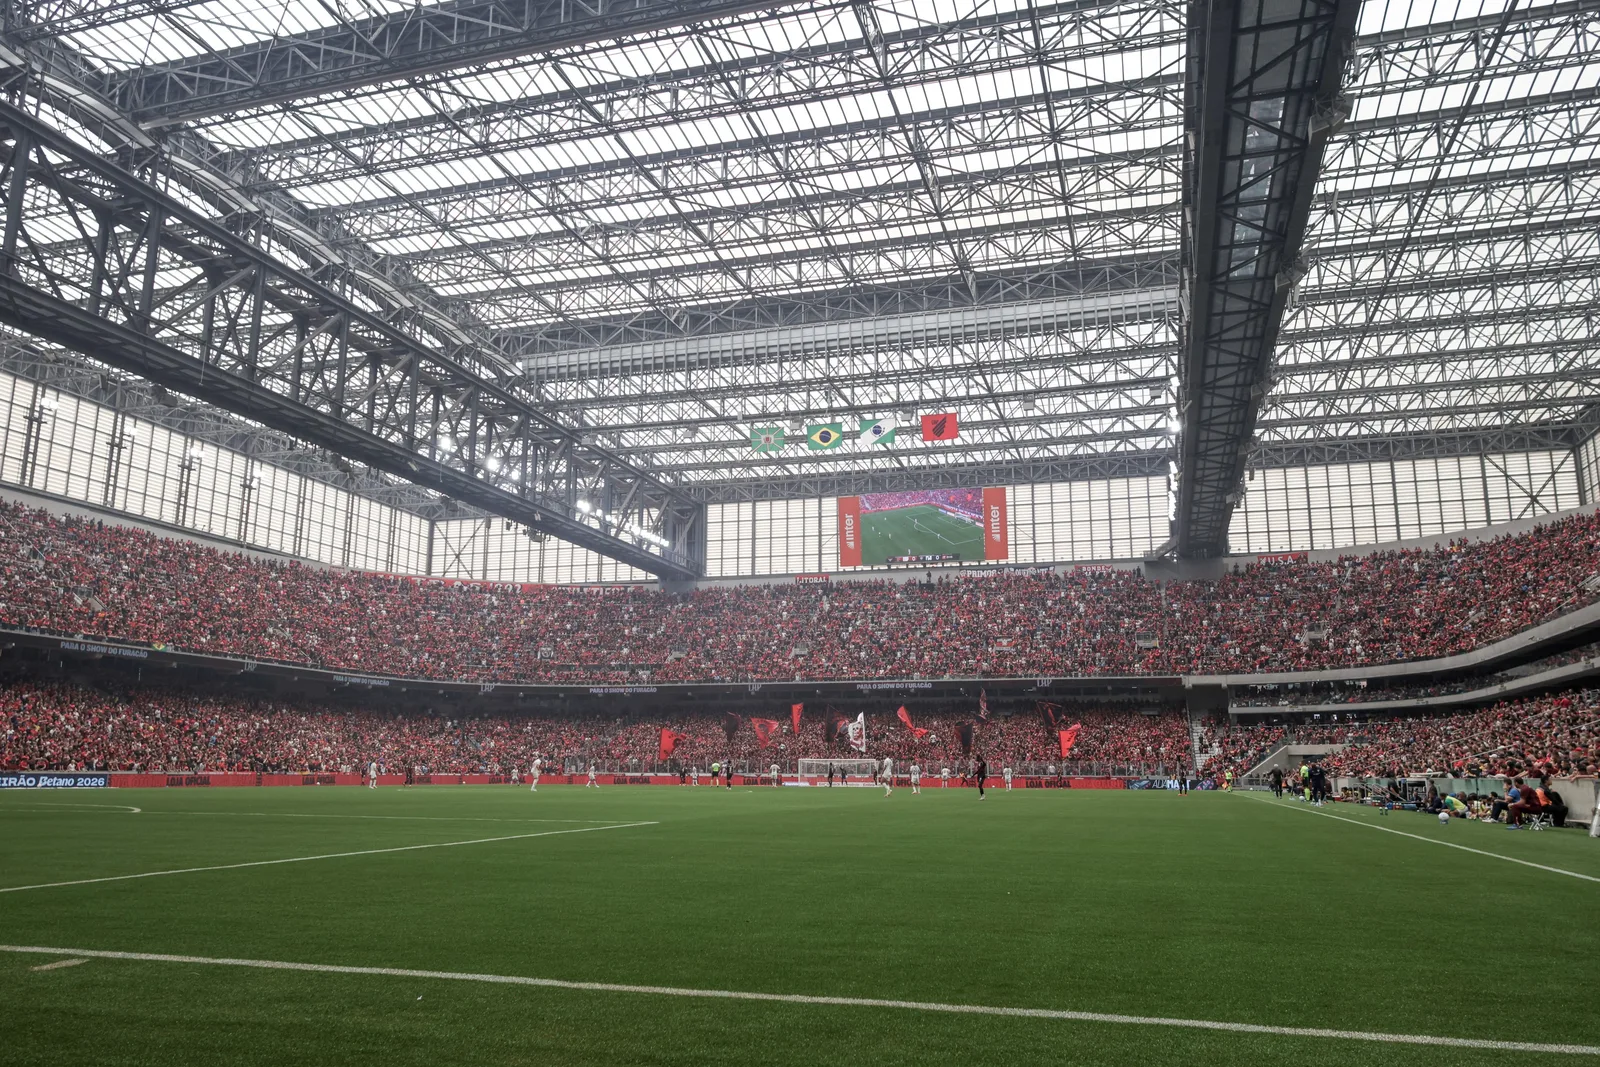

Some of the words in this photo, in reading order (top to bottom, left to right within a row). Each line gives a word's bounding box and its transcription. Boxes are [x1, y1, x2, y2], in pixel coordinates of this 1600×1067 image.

[60, 641, 79, 651] PARA
[86, 644, 107, 654] SHOW
[107, 647, 118, 655] DO
[40, 776, 75, 788] Betano
[77, 777, 105, 787] 2026
[166, 776, 184, 787] LOJA
[185, 775, 211, 786] OFICIAL
[613, 776, 628, 785] LOJA
[743, 777, 758, 786] LOJA
[1025, 780, 1043, 788] LOJA
